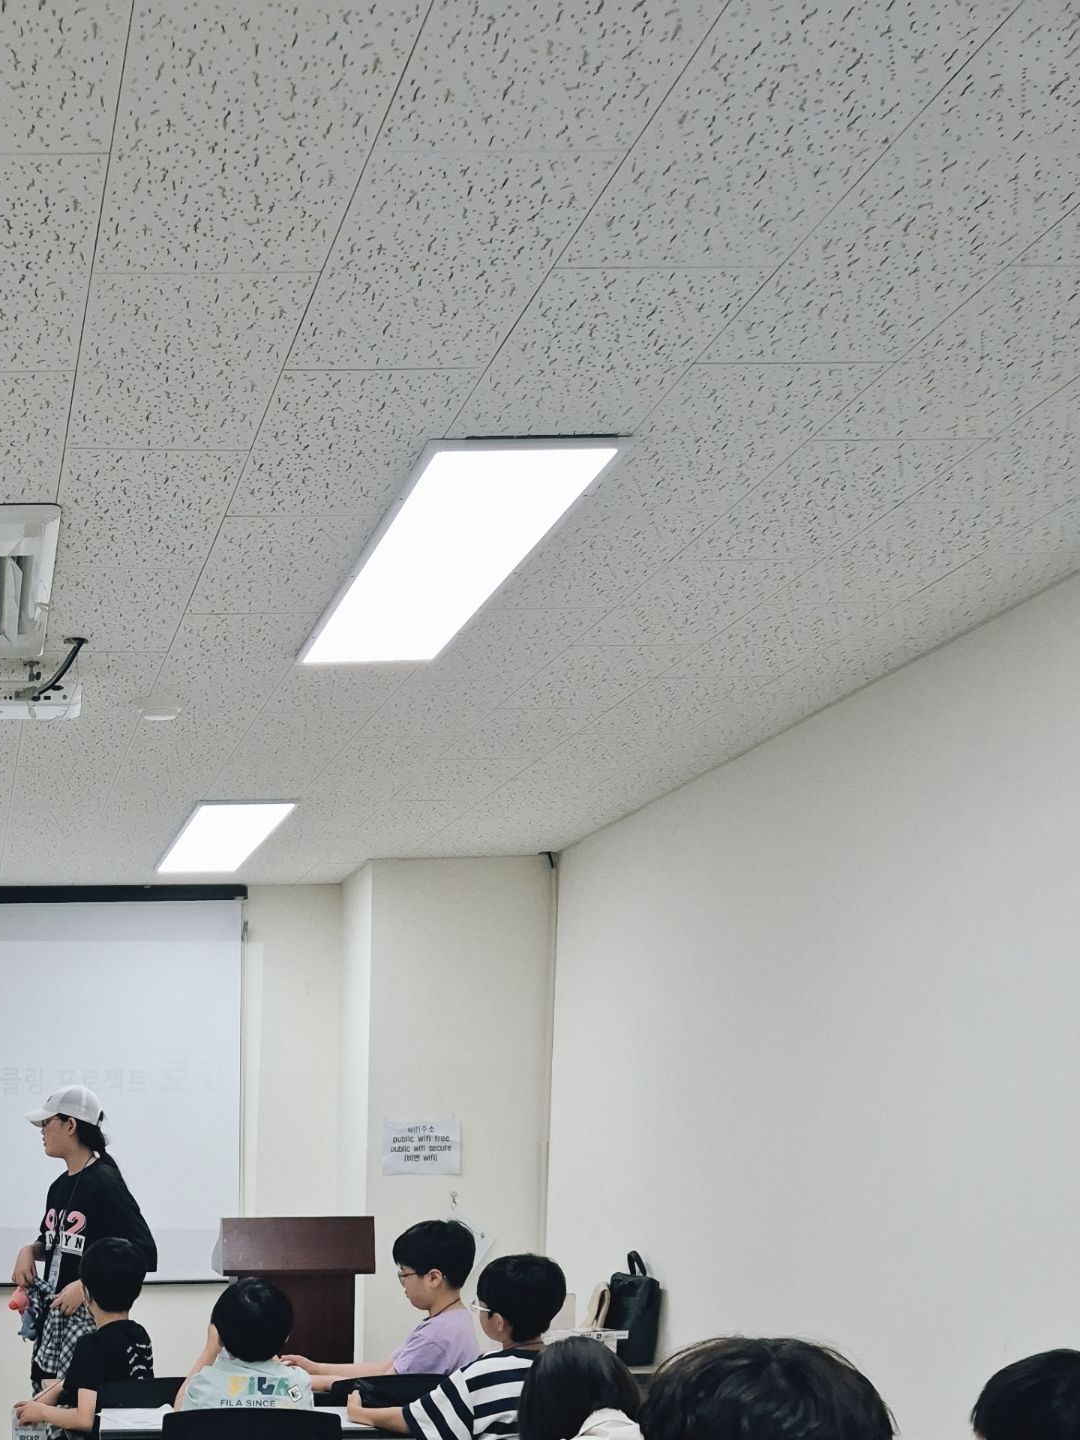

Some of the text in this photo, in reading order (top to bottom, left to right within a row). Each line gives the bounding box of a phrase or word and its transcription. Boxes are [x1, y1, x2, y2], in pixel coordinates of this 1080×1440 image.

[57, 1067, 149, 1094] 프로젝트
[392, 1135, 414, 1143] public
[390, 1145, 411, 1153] public
[219, 1399, 276, 1407] FILA SINCE
